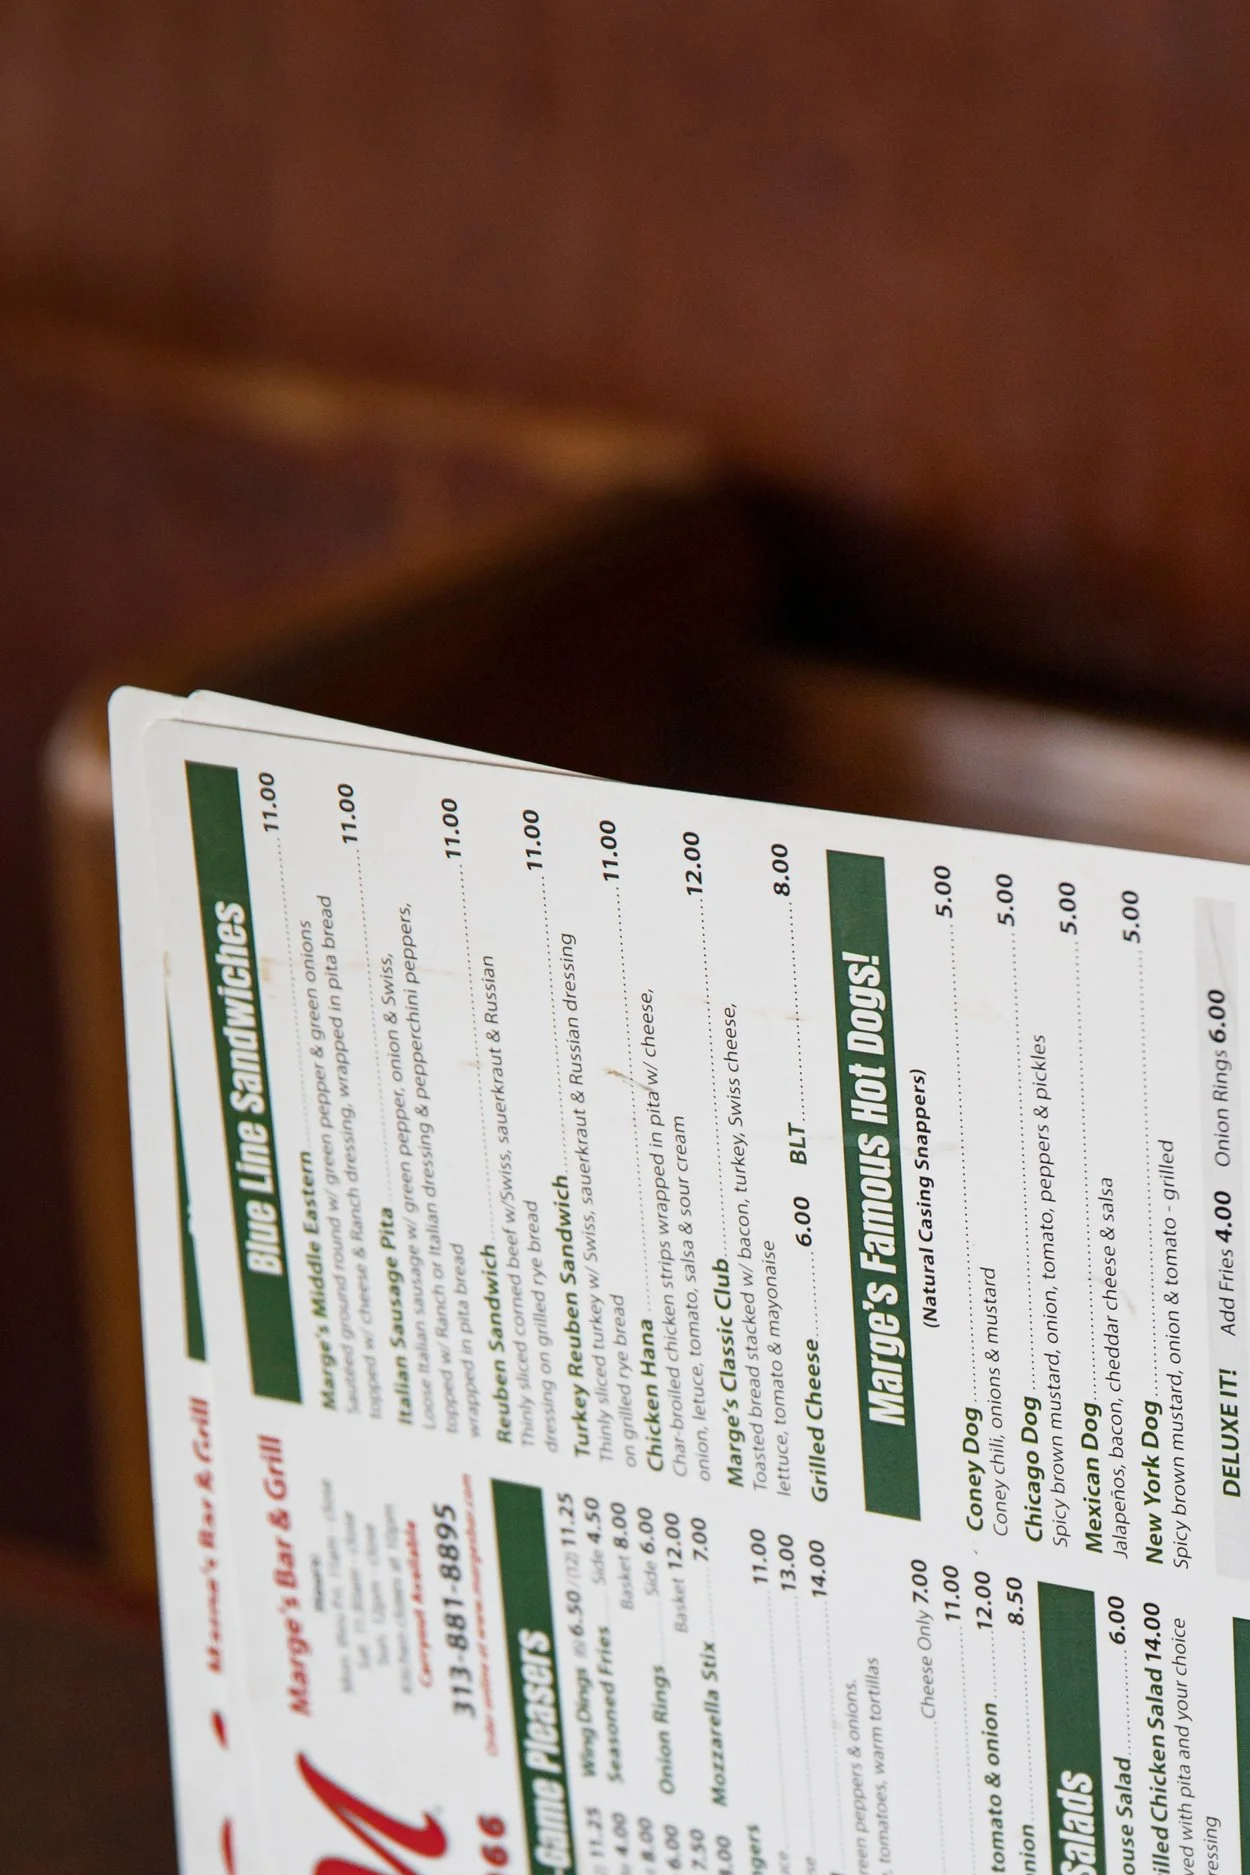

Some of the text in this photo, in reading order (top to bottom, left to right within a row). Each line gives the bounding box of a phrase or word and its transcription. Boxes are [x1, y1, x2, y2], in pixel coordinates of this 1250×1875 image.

[215, 901, 283, 1275] Blue Line Sandwiches
[256, 770, 337, 1412] Marge's Middle Eastern 11.00
[598, 819, 665, 1473] Chicken Hana 11.00
[682, 831, 745, 1488] Marge's Classic Club 12.00
[770, 843, 808, 1166] BLT 8.00
[792, 1195, 829, 1504] Grilled Cheese 6.00
[842, 951, 906, 1426] Marge's Famous Hot Dogs!
[908, 1068, 941, 1329] (Natural Casing Snappers)
[932, 864, 986, 1533] Coney Dog 5.00
[994, 872, 1045, 1544] Chicago Dog 5.00
[1119, 889, 1165, 1565] New York Dog 5.00
[256, 1433, 312, 1718] Marge's Bar & Grill
[431, 1502, 477, 1719] 313-881-8895
[518, 1629, 562, 1773] Pleasers
[689, 1516, 728, 1808] Mozzarella Stix 7.00
[1107, 1595, 1127, 1646] 6.00
[1112, 1755, 1134, 1820] Salad
